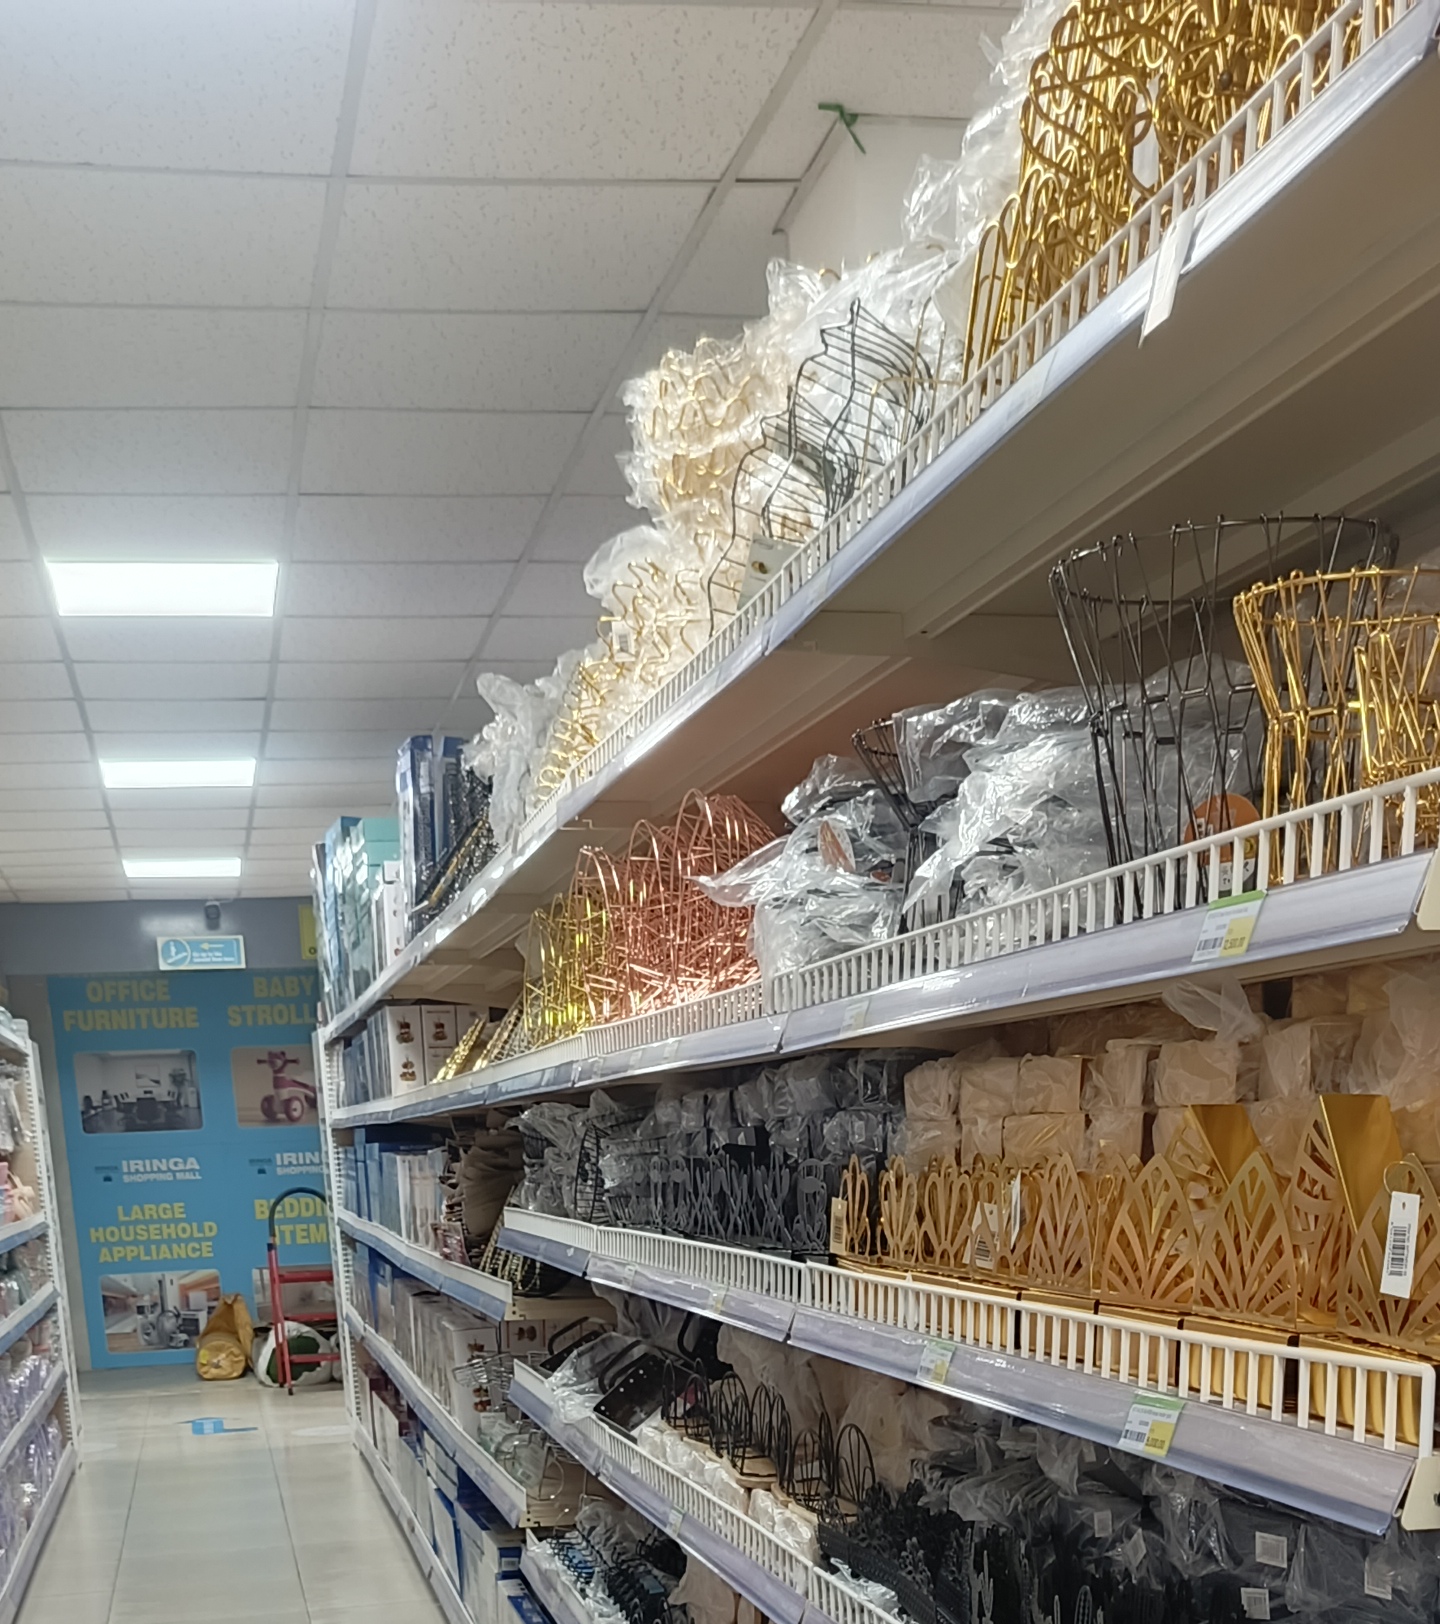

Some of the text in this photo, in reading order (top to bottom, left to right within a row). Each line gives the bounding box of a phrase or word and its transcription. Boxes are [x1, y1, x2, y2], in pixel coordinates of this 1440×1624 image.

[86, 979, 171, 1003] OFFICE
[253, 975, 315, 998] BABY
[63, 1007, 199, 1031] FURNITURE
[228, 1004, 318, 1027] STROLL
[122, 1157, 200, 1172] IRINGA
[275, 1152, 321, 1166] IRIN
[122, 1171, 202, 1183] SHOPPING MALL
[117, 1202, 187, 1222] LARGE
[254, 1197, 325, 1220] BEDDI
[89, 1221, 218, 1243] HOUSEHOLD
[274, 1223, 328, 1246] ITEM
[99, 1241, 214, 1263] APPLIANCE
